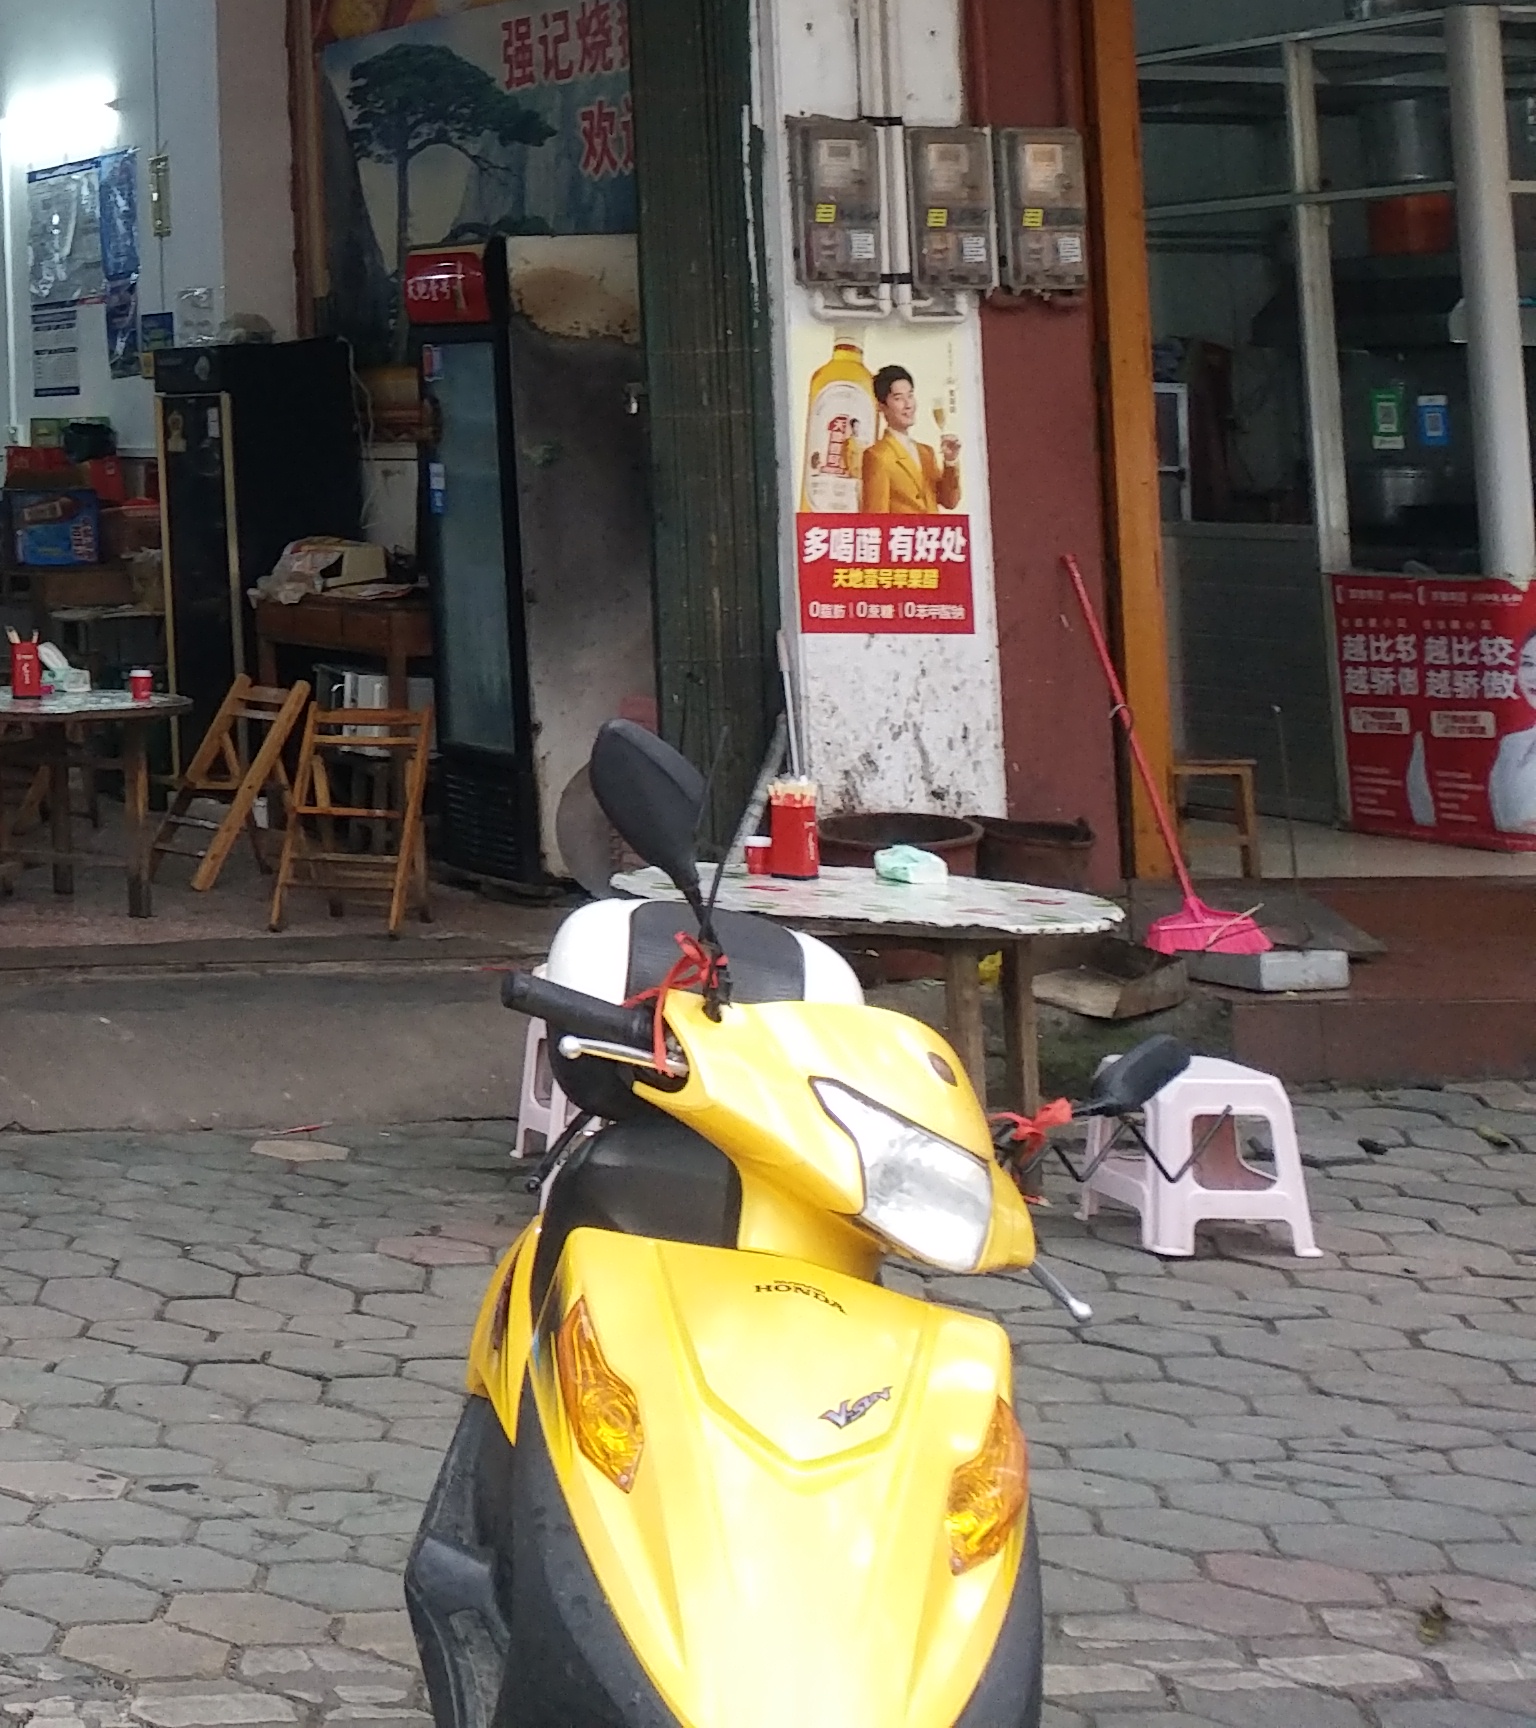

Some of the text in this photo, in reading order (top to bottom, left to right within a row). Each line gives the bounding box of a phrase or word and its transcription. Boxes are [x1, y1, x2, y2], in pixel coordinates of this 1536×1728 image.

[803, 525, 968, 563] 多喝醋 有好处
[754, 1284, 848, 1315] HONDA
